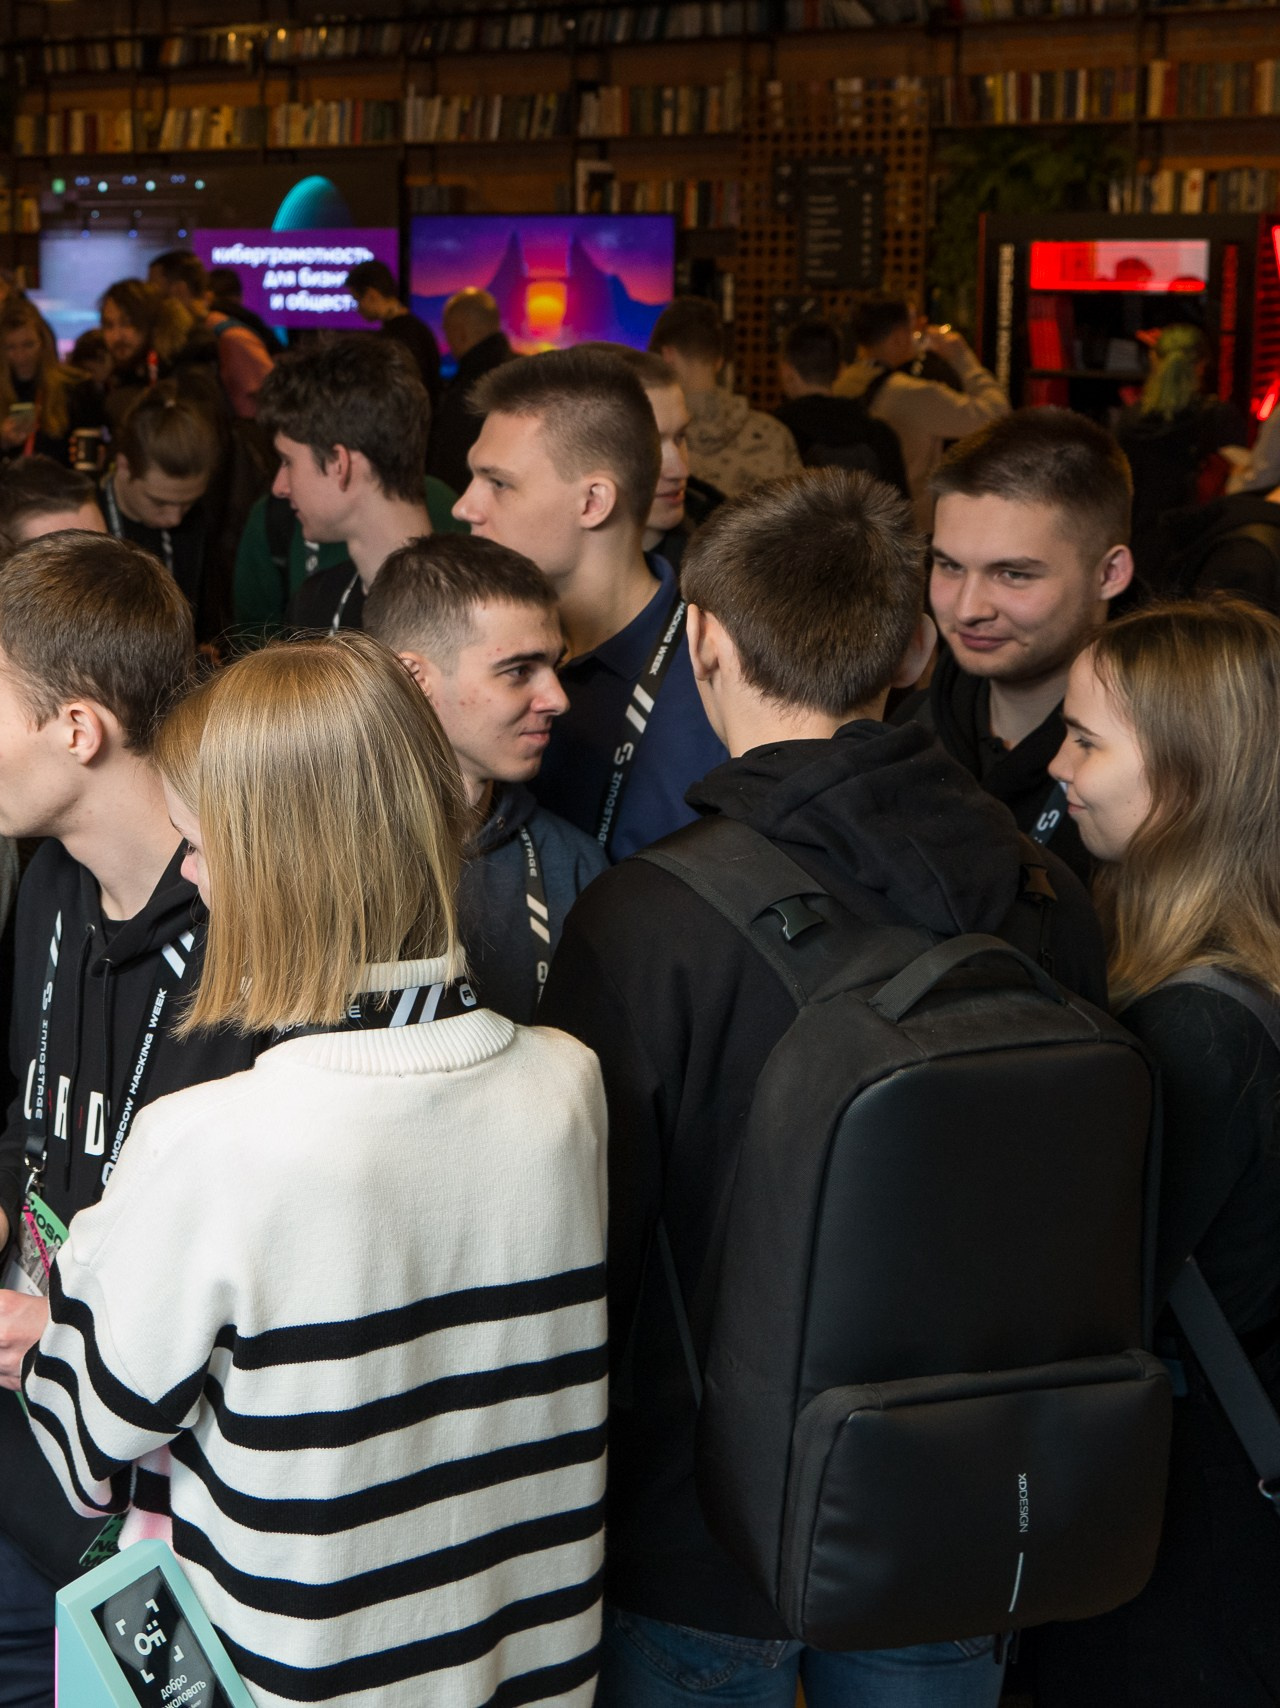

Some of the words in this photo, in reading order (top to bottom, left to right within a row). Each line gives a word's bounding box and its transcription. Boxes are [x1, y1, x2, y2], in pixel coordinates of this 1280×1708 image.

[298, 266, 349, 288] бизн
[648, 646, 668, 675] WEEK
[110, 1096, 134, 1162] MOSCOW
[129, 1033, 154, 1095] HACKING
[148, 987, 167, 1028] WEEK
[160, 1674, 187, 1700] добро
[164, 1680, 206, 1708] жаловать
